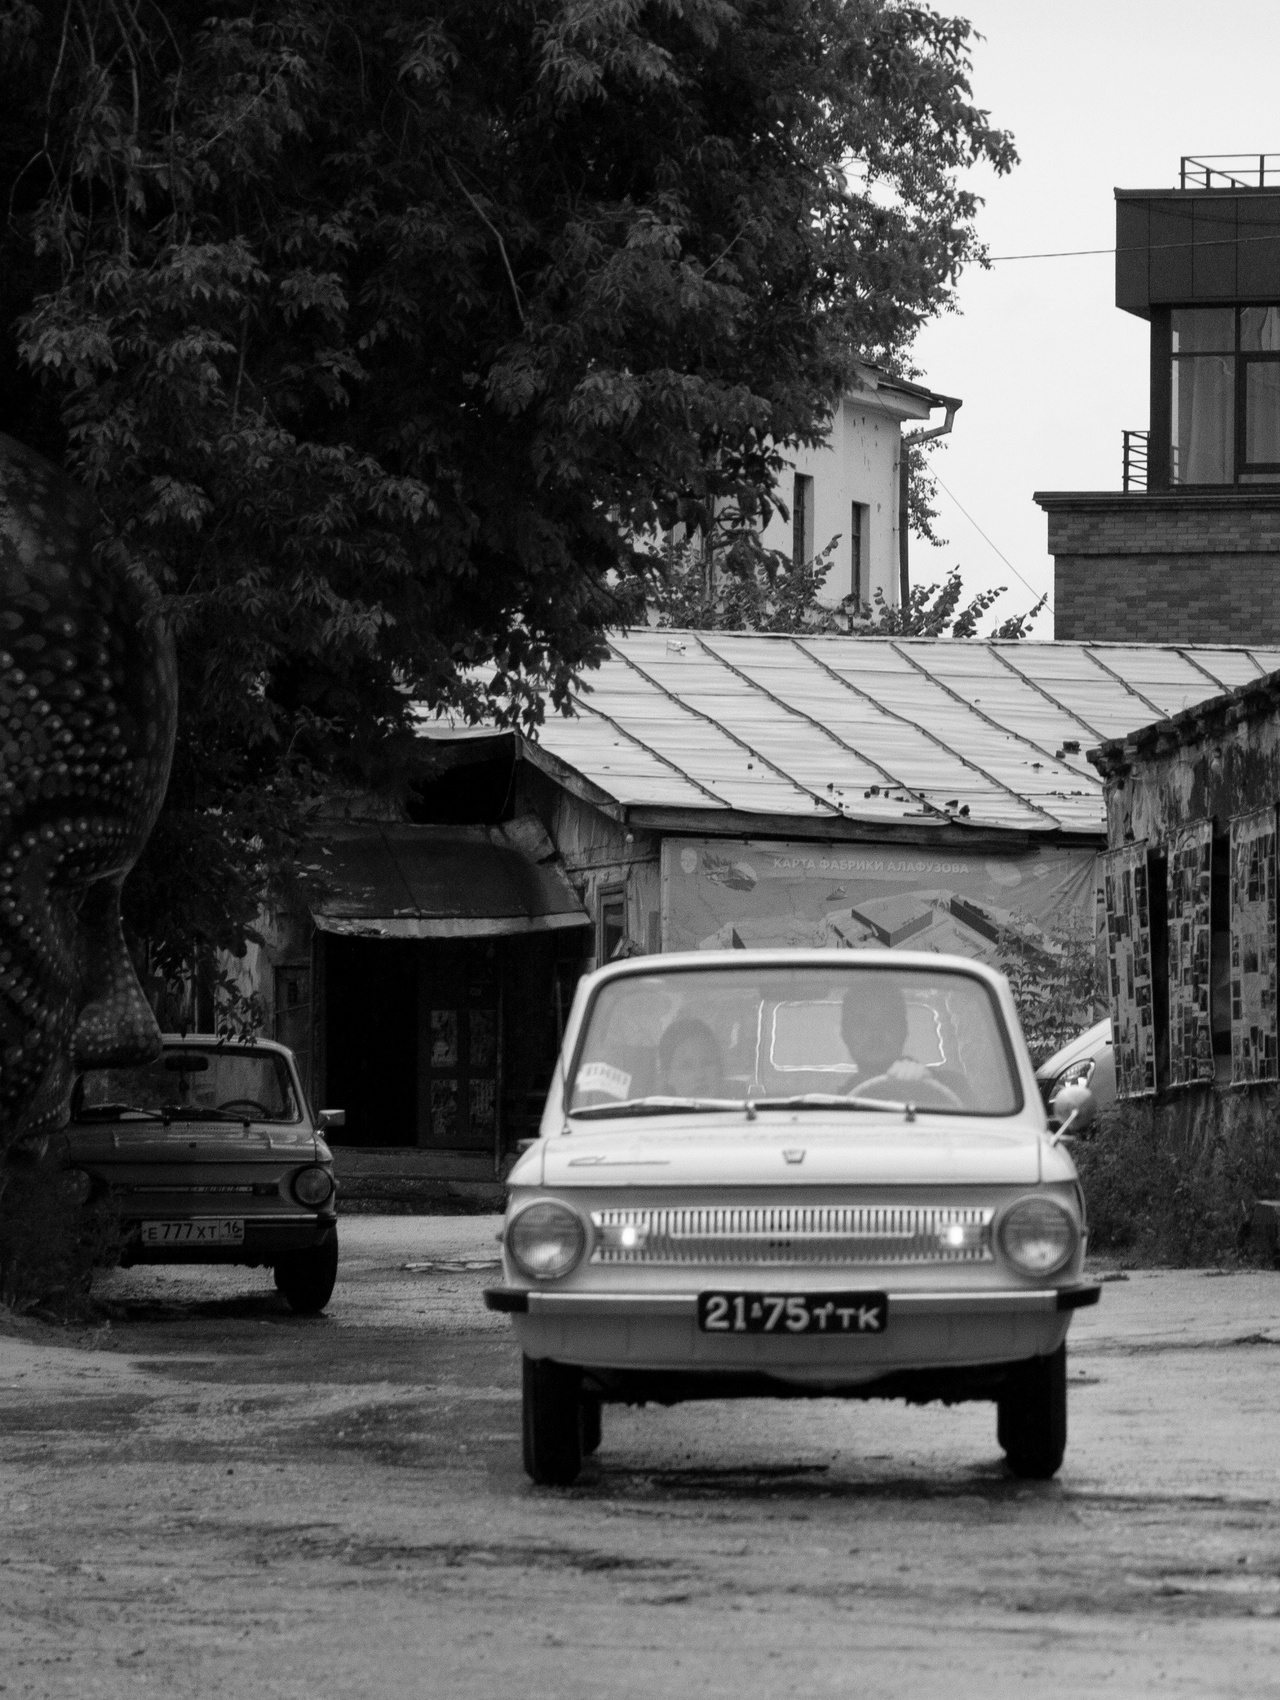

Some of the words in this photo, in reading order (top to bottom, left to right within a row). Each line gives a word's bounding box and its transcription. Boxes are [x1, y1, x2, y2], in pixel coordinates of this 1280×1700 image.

[773, 858, 816, 870] КАРТА
[820, 859, 884, 872] ФАБРИКИ
[886, 861, 970, 874] АЛАФУЗОВА
